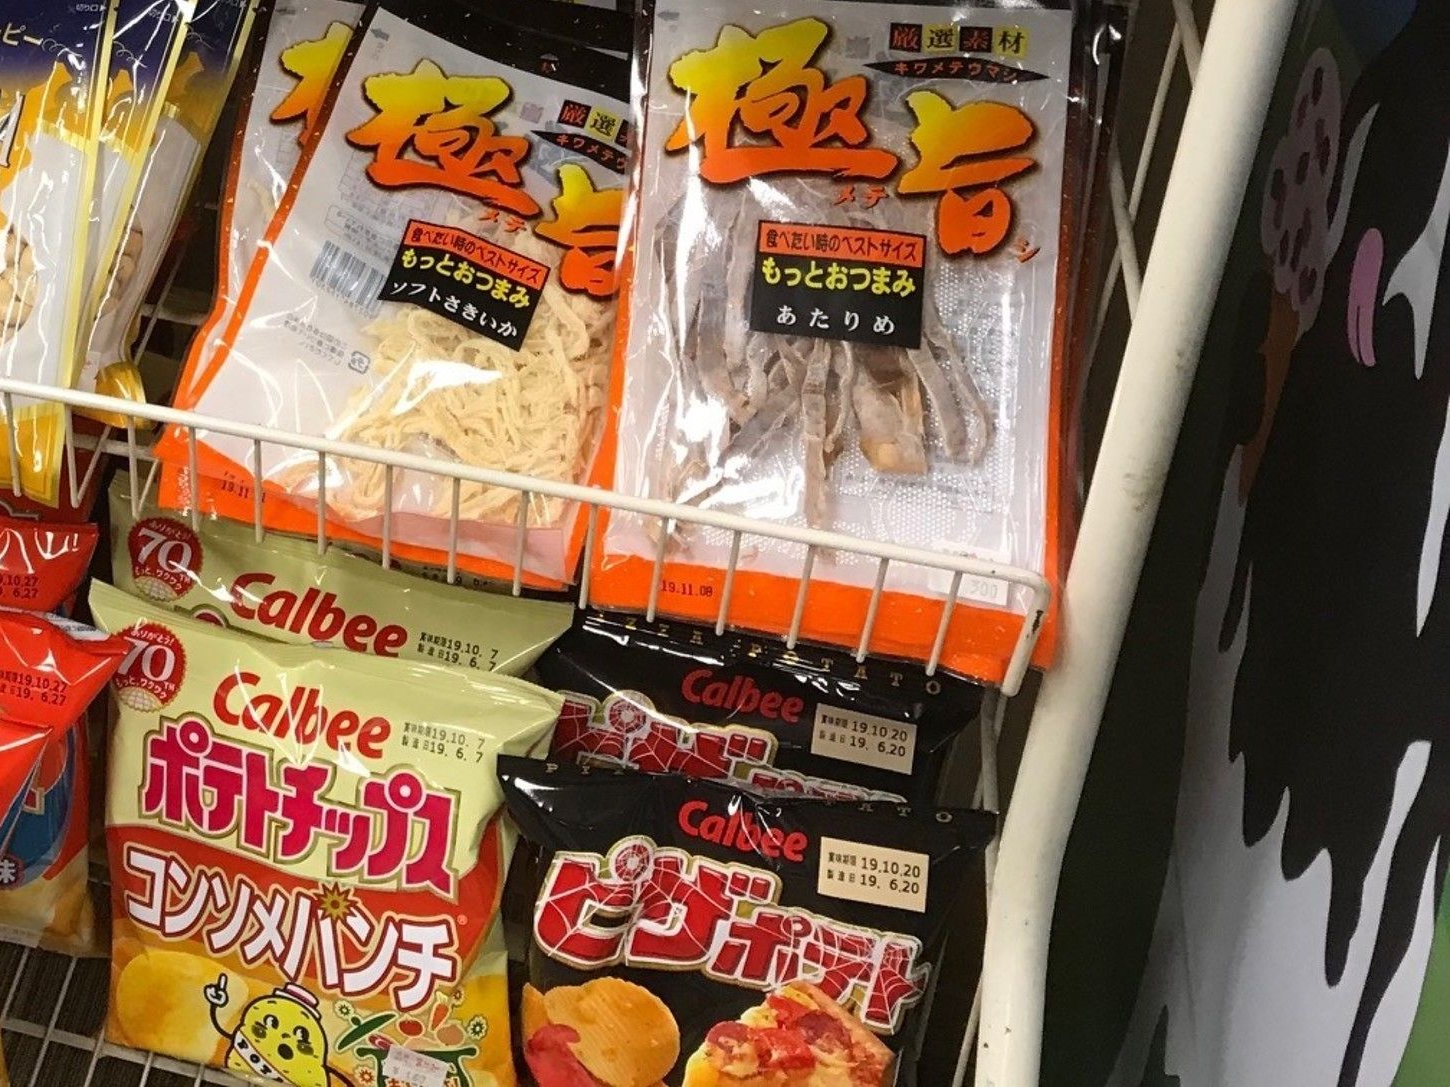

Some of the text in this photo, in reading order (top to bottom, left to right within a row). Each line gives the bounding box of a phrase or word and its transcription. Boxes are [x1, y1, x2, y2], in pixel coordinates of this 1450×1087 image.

[890, 24, 1028, 55] 厳選素材
[894, 60, 1018, 83] キワメテウマシ
[410, 226, 542, 284] 食べたい時のベストサイズ
[764, 226, 920, 265] 食べたい時のベストサイズ
[400, 248, 532, 309] もっとおつまみ
[759, 258, 917, 298] もっとおつまみ
[390, 280, 518, 338] ソフトさきいか
[776, 304, 896, 338] あたりめ
[136, 527, 192, 573] 70
[661, 581, 714, 598] 19.11.08
[229, 572, 408, 658] Calbee
[116, 636, 176, 683] 70
[40, 692, 67, 707] 6.27
[213, 671, 392, 760] Calbee
[681, 668, 806, 725] Calbee
[852, 720, 908, 743] 19.10.20
[142, 720, 458, 903] ポテトチップス
[678, 800, 809, 863] Calbee
[861, 857, 921, 879] 19.10.20
[889, 879, 920, 895] 6.20
[124, 842, 457, 1013] コンソメパンチ
[534, 835, 932, 1036] ピザポテト
